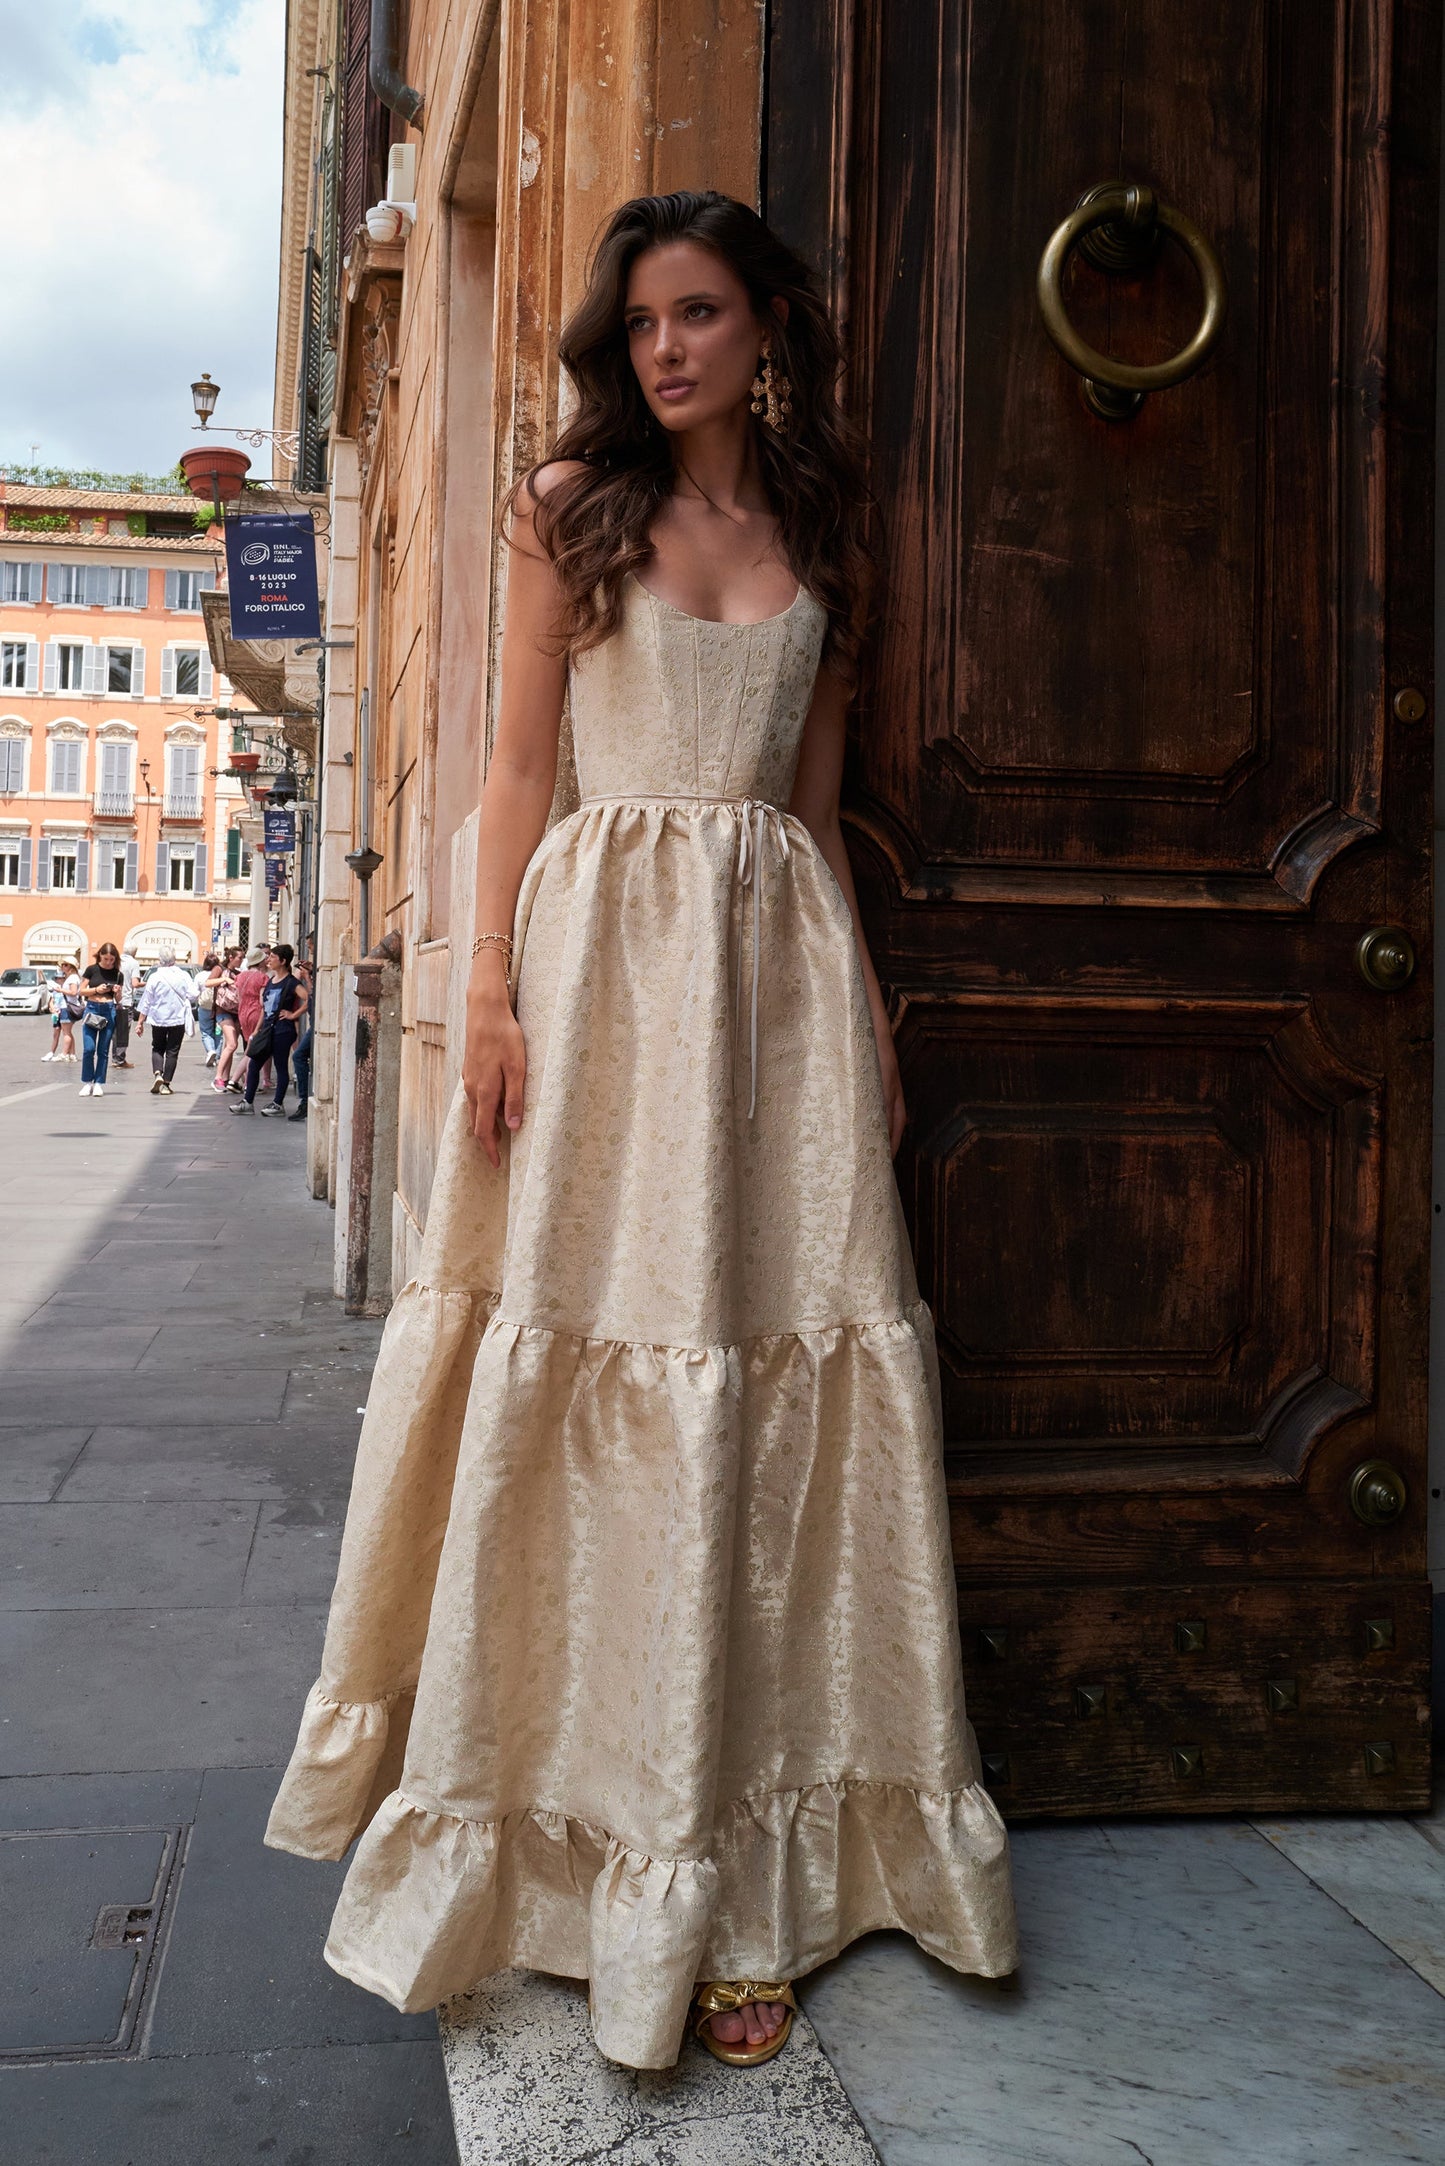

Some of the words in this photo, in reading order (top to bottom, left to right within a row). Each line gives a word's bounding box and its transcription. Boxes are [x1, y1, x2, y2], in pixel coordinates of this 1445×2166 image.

[245, 604, 270, 612] FORO
[271, 603, 306, 612] ITALICO
[38, 934, 74, 942] FRETTE
[144, 937, 180, 945] FRETTE
